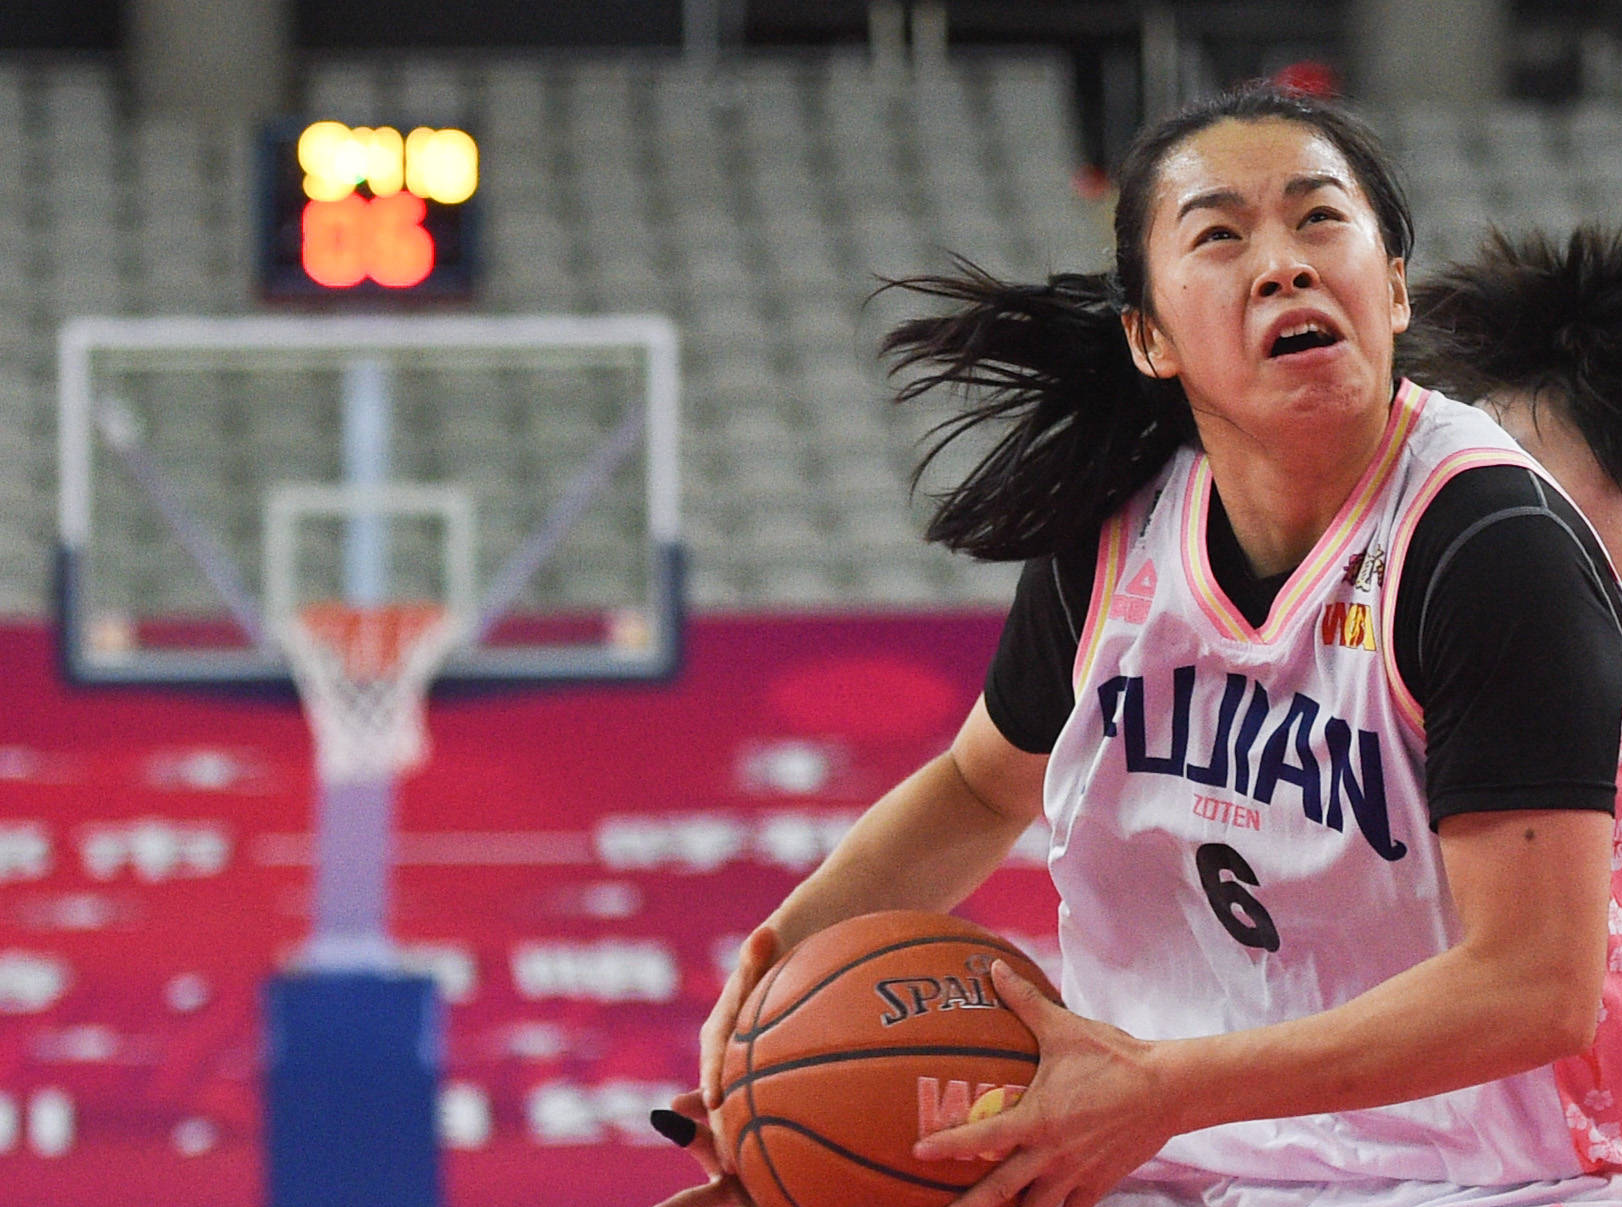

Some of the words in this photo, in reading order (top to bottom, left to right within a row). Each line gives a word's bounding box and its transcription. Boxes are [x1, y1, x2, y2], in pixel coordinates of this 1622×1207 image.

[1193, 793, 1260, 831] ZOTEN
[1196, 842, 1280, 953] 6
[874, 974, 1000, 1028] SPAL
